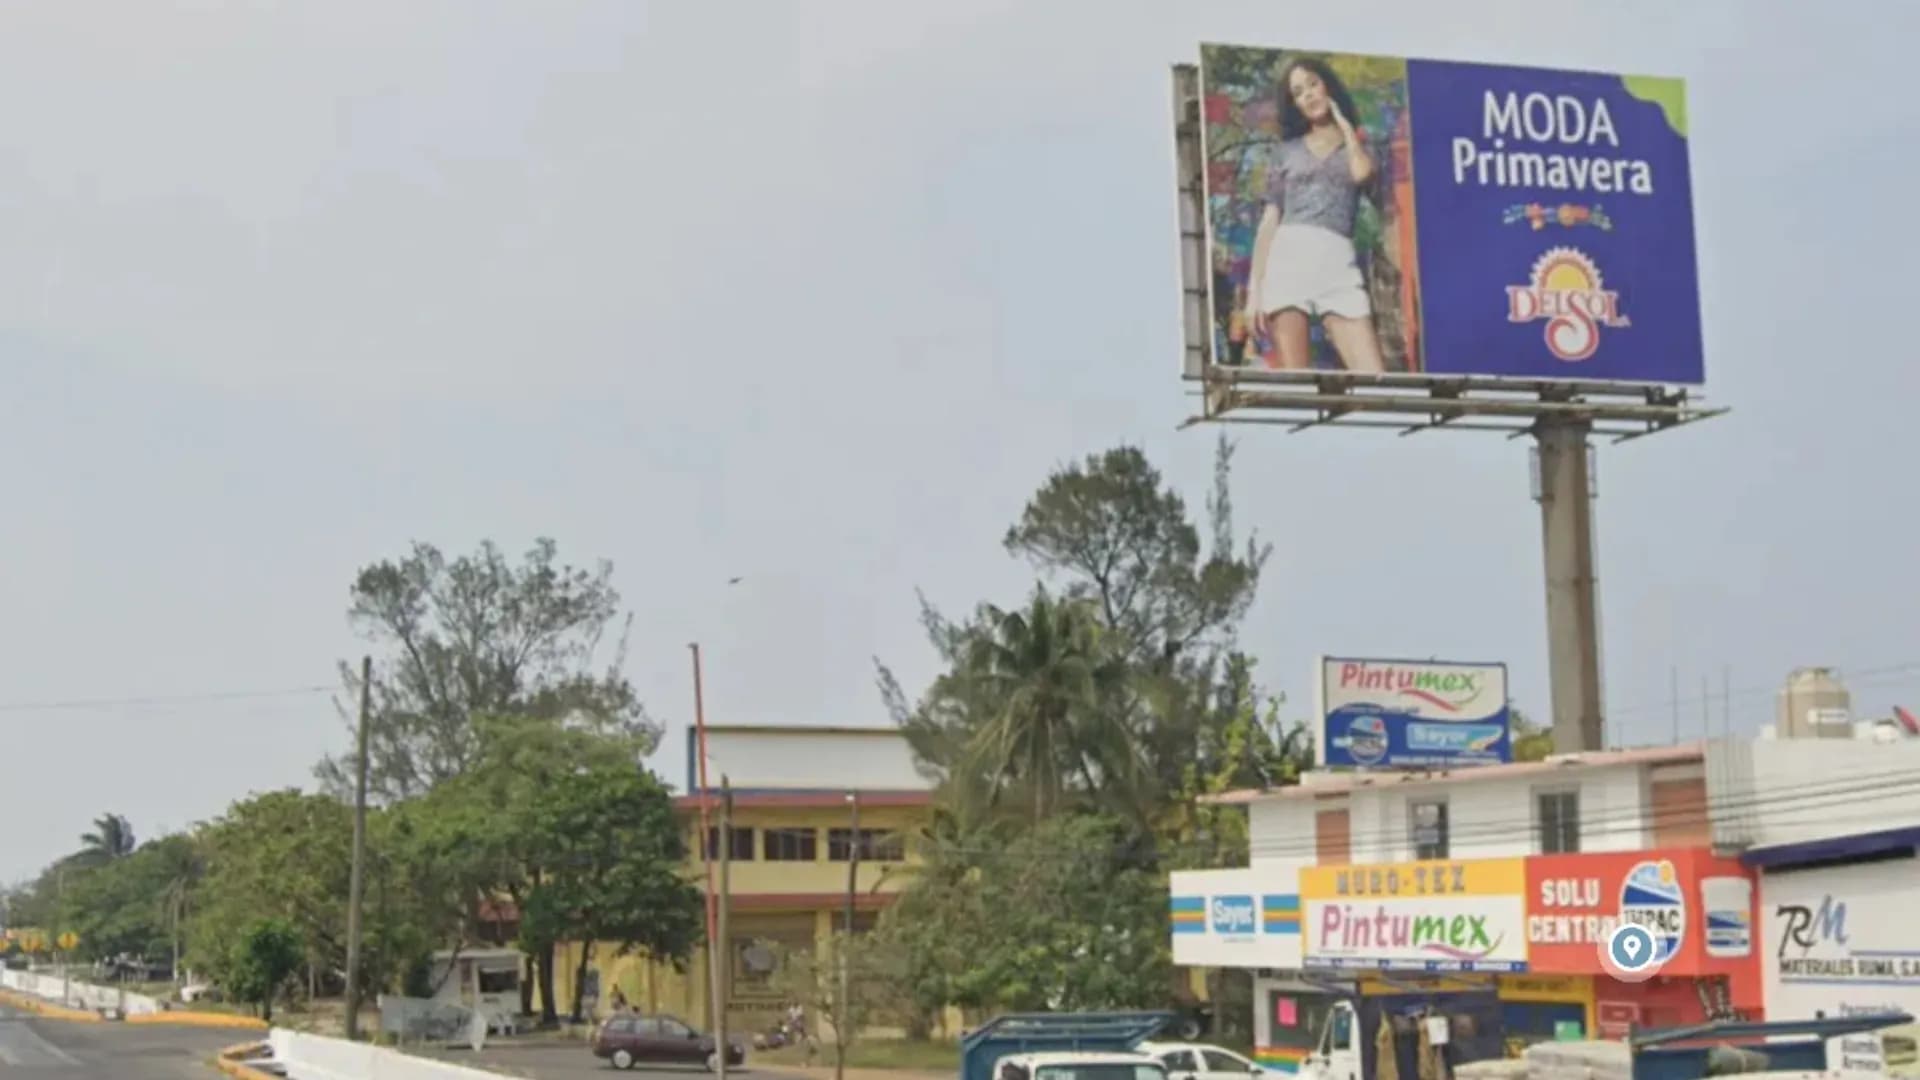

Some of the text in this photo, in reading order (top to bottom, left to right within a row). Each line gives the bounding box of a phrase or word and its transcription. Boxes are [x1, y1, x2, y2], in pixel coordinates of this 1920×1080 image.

[1483, 90, 1619, 147] MODA
[1452, 137, 1653, 194] Primavera
[1340, 663, 1475, 690] Pintumex
[1541, 879, 1601, 907] SOLU
[1320, 905, 1490, 947] Pintumex
[1777, 894, 1848, 958] RM
[1779, 960, 1853, 975] MATERIALES
